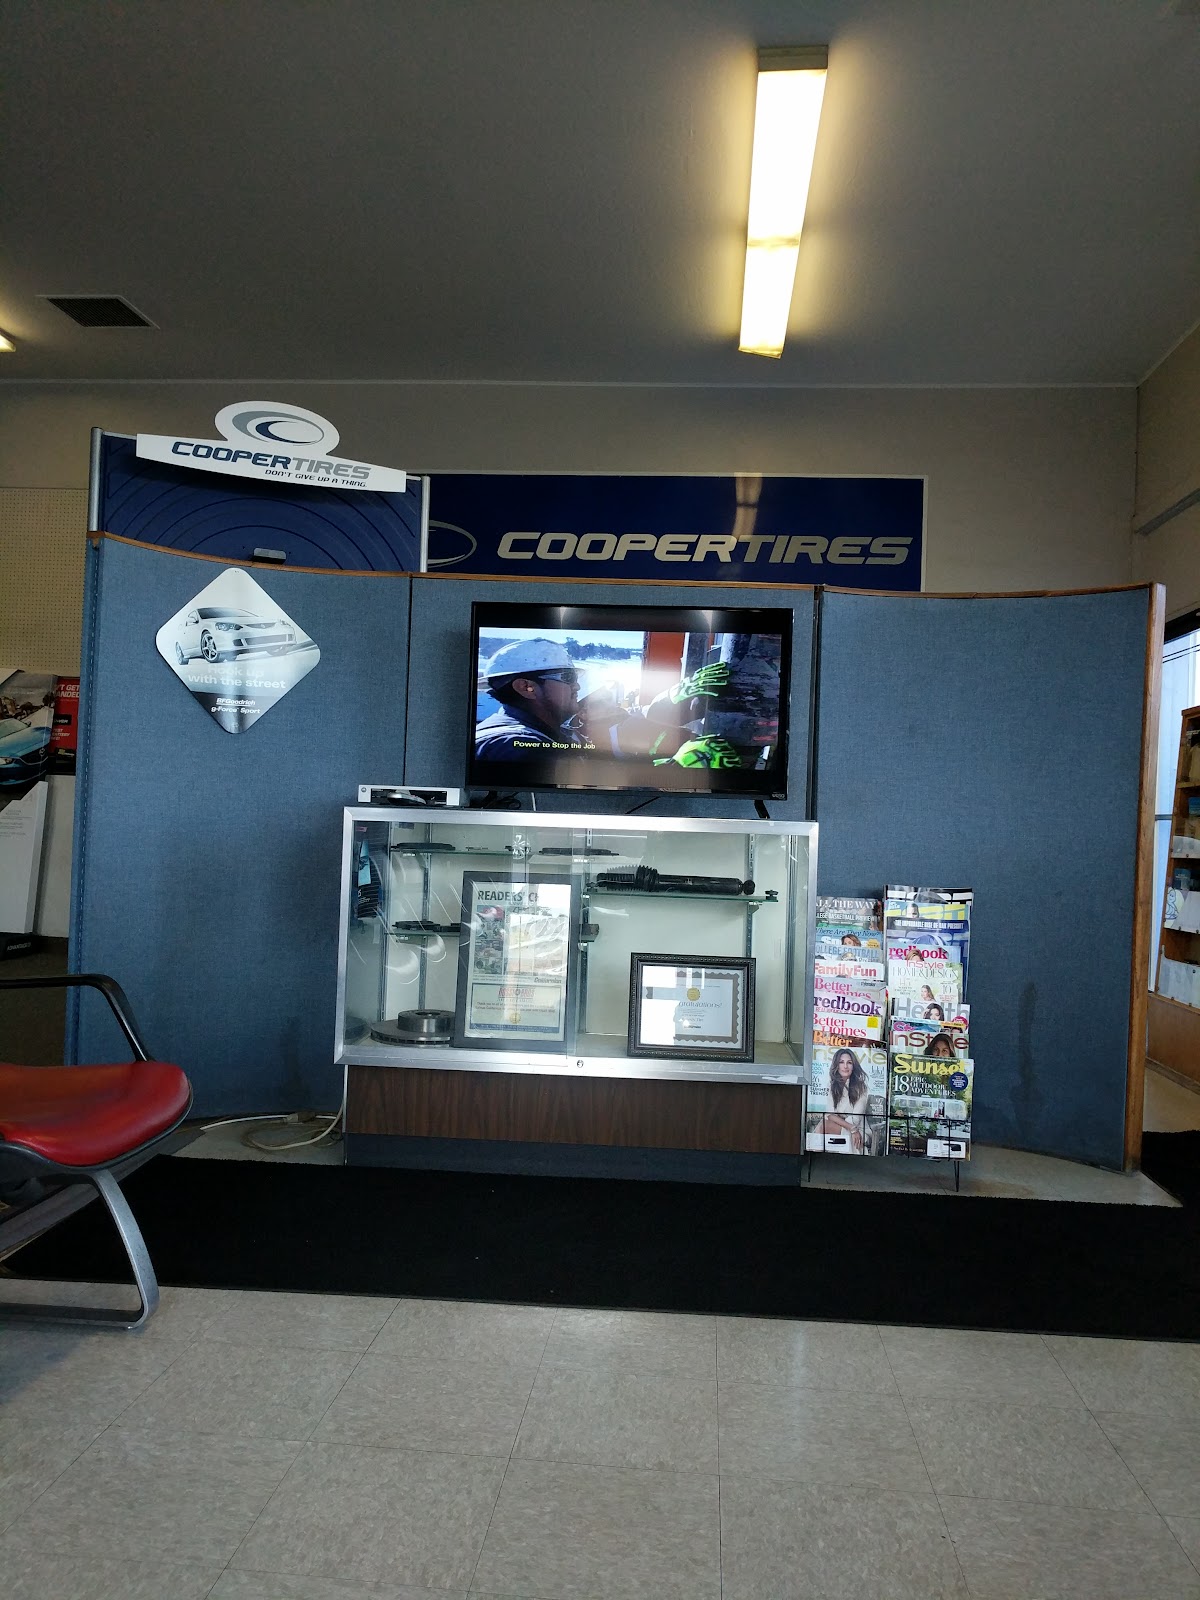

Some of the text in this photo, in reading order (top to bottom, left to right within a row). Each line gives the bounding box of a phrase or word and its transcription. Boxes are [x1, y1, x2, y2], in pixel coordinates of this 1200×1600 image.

[171, 441, 372, 480] COOPERTIRES
[264, 469, 293, 478] DON'T
[295, 473, 315, 481] GIVE
[317, 475, 330, 483] UP
[497, 531, 914, 565] COOPERTIRES
[246, 667, 264, 679] up
[188, 674, 286, 689] with the street
[216, 697, 256, 706] BFGoodrich
[513, 740, 541, 748] Power
[551, 741, 569, 750] Stop
[833, 899, 854, 909] THE
[855, 900, 876, 910] WAY
[815, 943, 842, 956] OLLEGE
[814, 978, 852, 992] Better
[813, 995, 882, 1016] redbook
[813, 1031, 853, 1047] Better
[893, 1053, 965, 1076] Sunset
[892, 1075, 910, 1093] 18
[909, 1082, 945, 1091] OUTDOOR
[910, 1087, 956, 1097] ADVENTURES
